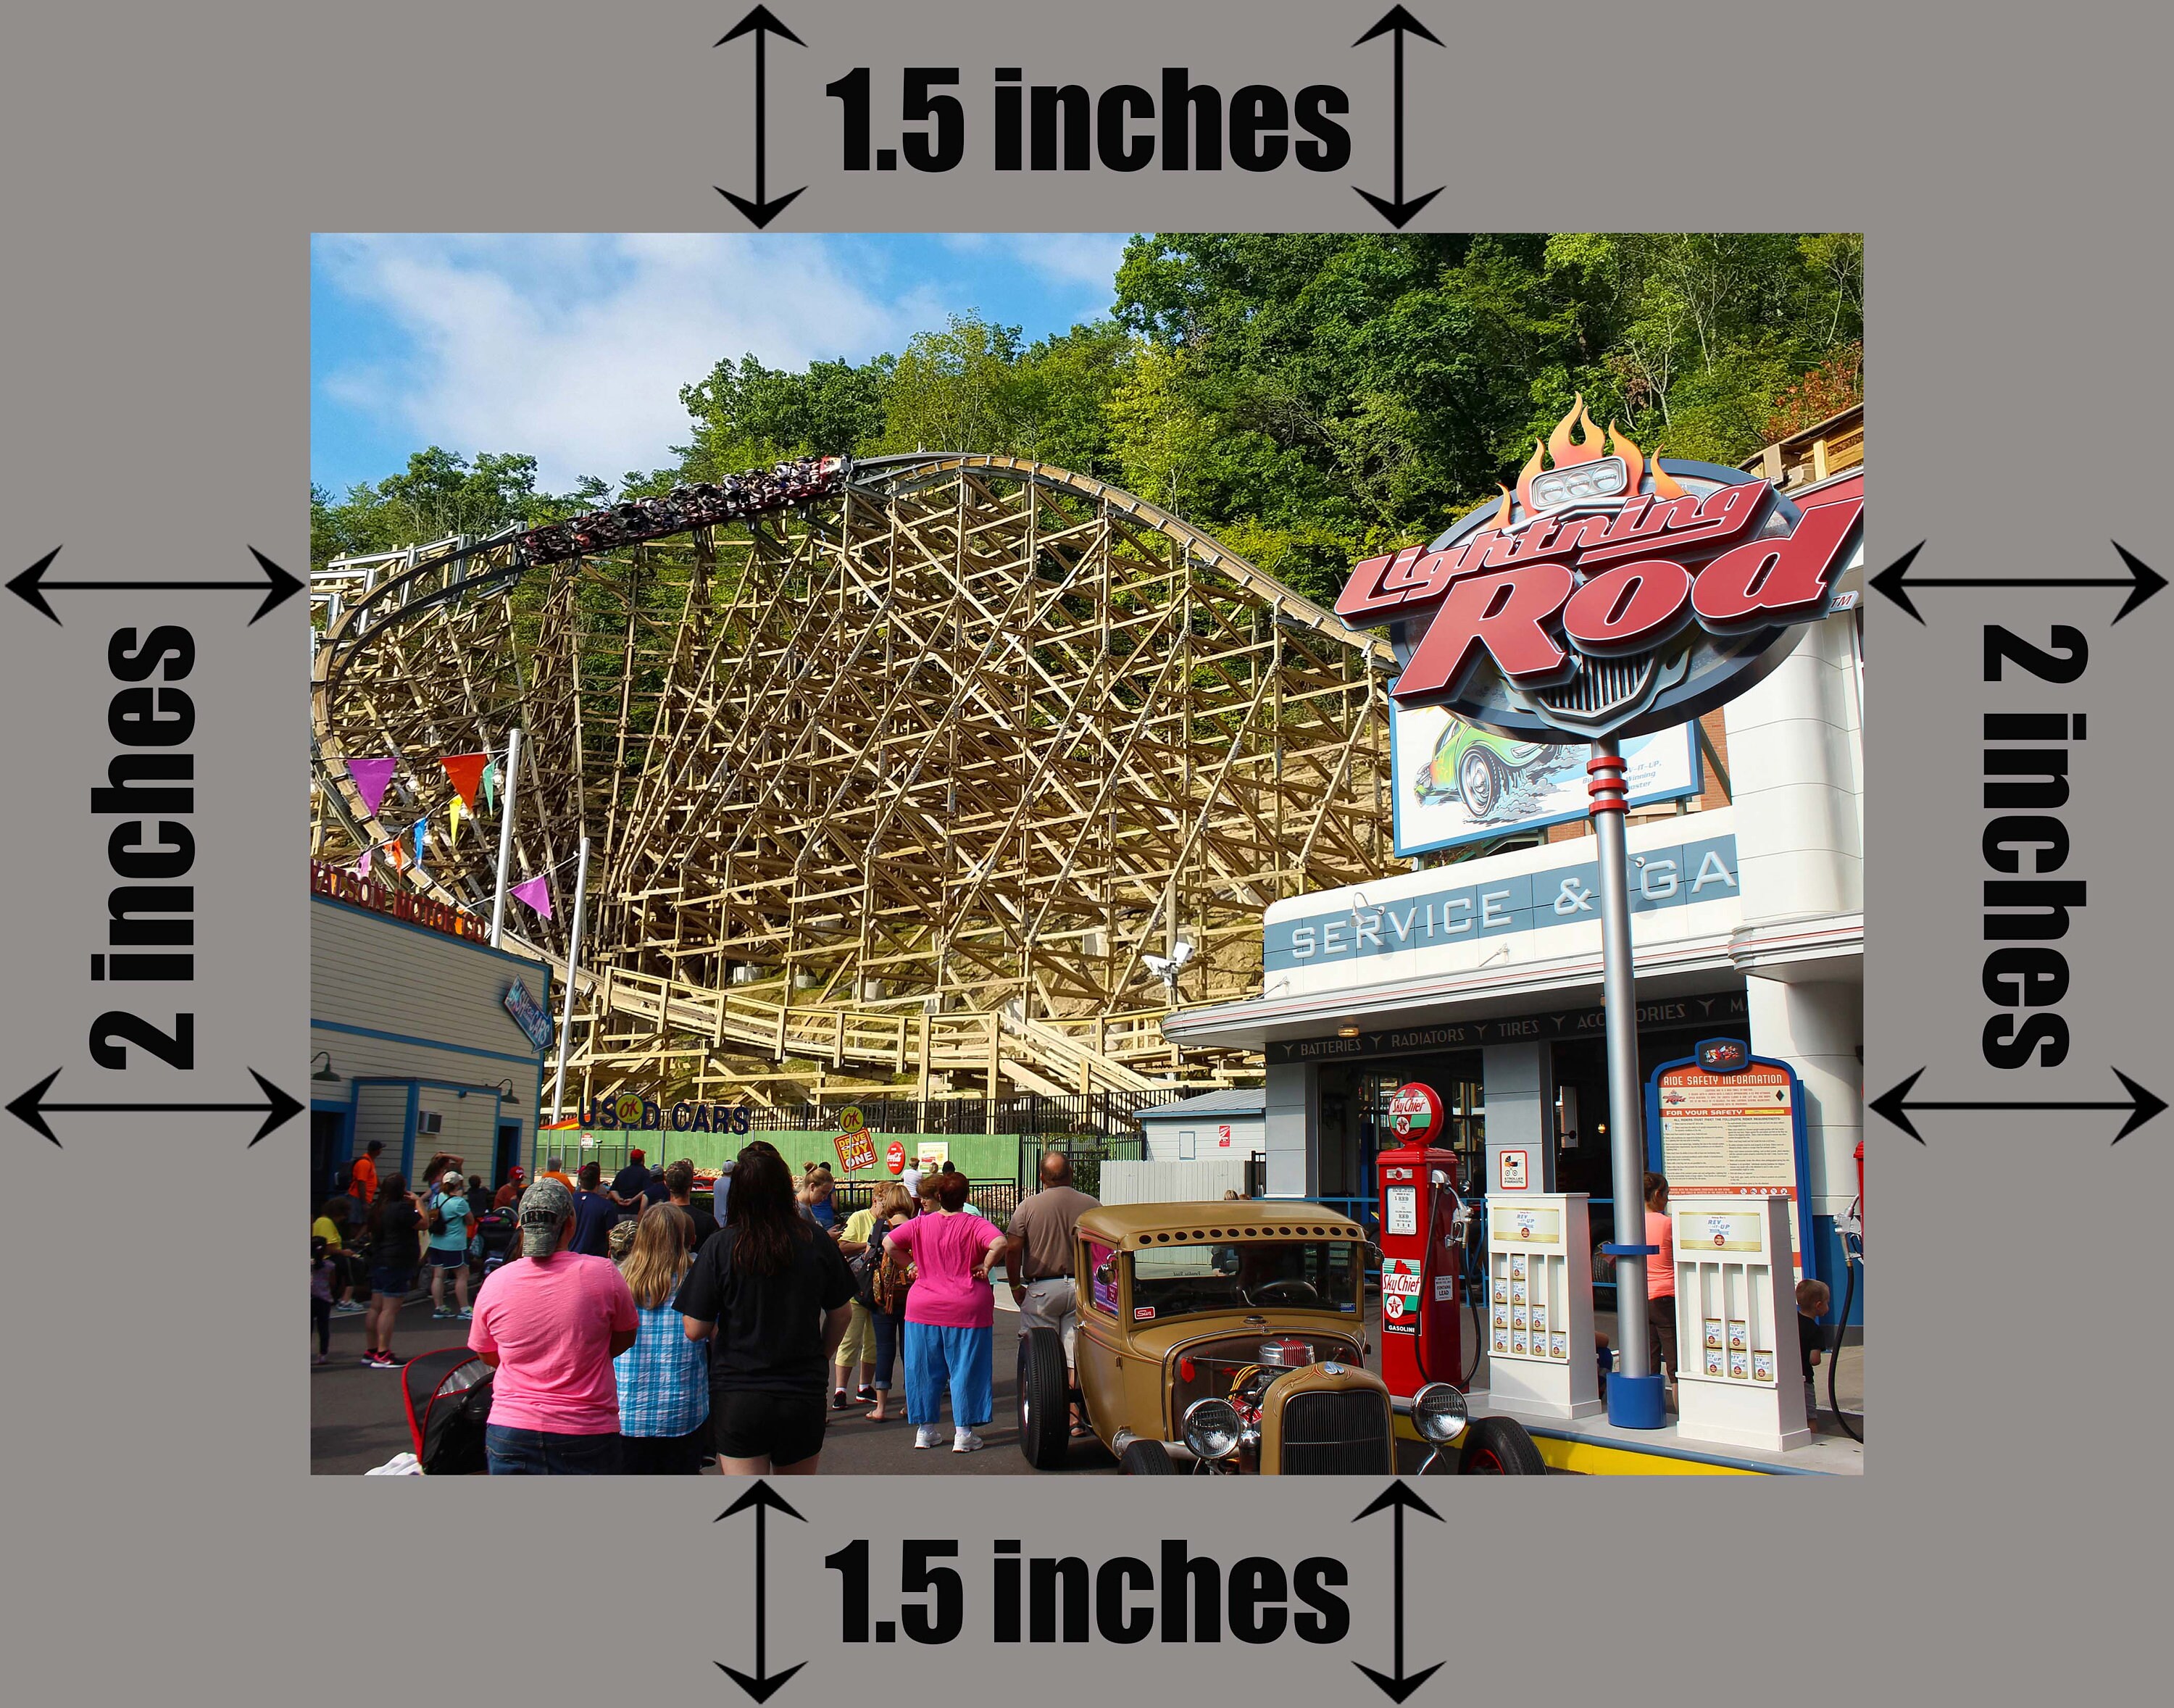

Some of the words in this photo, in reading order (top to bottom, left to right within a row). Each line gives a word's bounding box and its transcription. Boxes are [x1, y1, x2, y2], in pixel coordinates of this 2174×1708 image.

[1334, 478, 1773, 617] Lightning
[1389, 496, 1864, 698] Rod
[1831, 594, 1853, 609] TM
[393, 888, 457, 933] MOTOR
[1292, 890, 1513, 959] SERVICE
[1554, 878, 1593, 916] &
[530, 1010, 550, 1044] CARS
[1301, 1038, 1362, 1056] BATTERIES
[1391, 1028, 1465, 1048] RADIATORS
[1498, 1020, 1540, 1037] TIRES
[1664, 1076, 1683, 1086] RIDE
[1687, 1075, 1718, 1086] SAFETY
[1723, 1075, 1783, 1085] INFORMATION
[578, 1096, 661, 1130] USD
[671, 1101, 749, 1136] CARS
[620, 1098, 639, 1118] OK
[1392, 1099, 1404, 1114] Sky
[1404, 1098, 1426, 1112] Chief
[844, 1110, 859, 1127] OK
[838, 1133, 866, 1146] DRIVE
[842, 1143, 867, 1159] BUY
[846, 1151, 872, 1166] ONE
[1383, 1274, 1397, 1294] Sky
[1397, 1275, 1420, 1292] Chief
